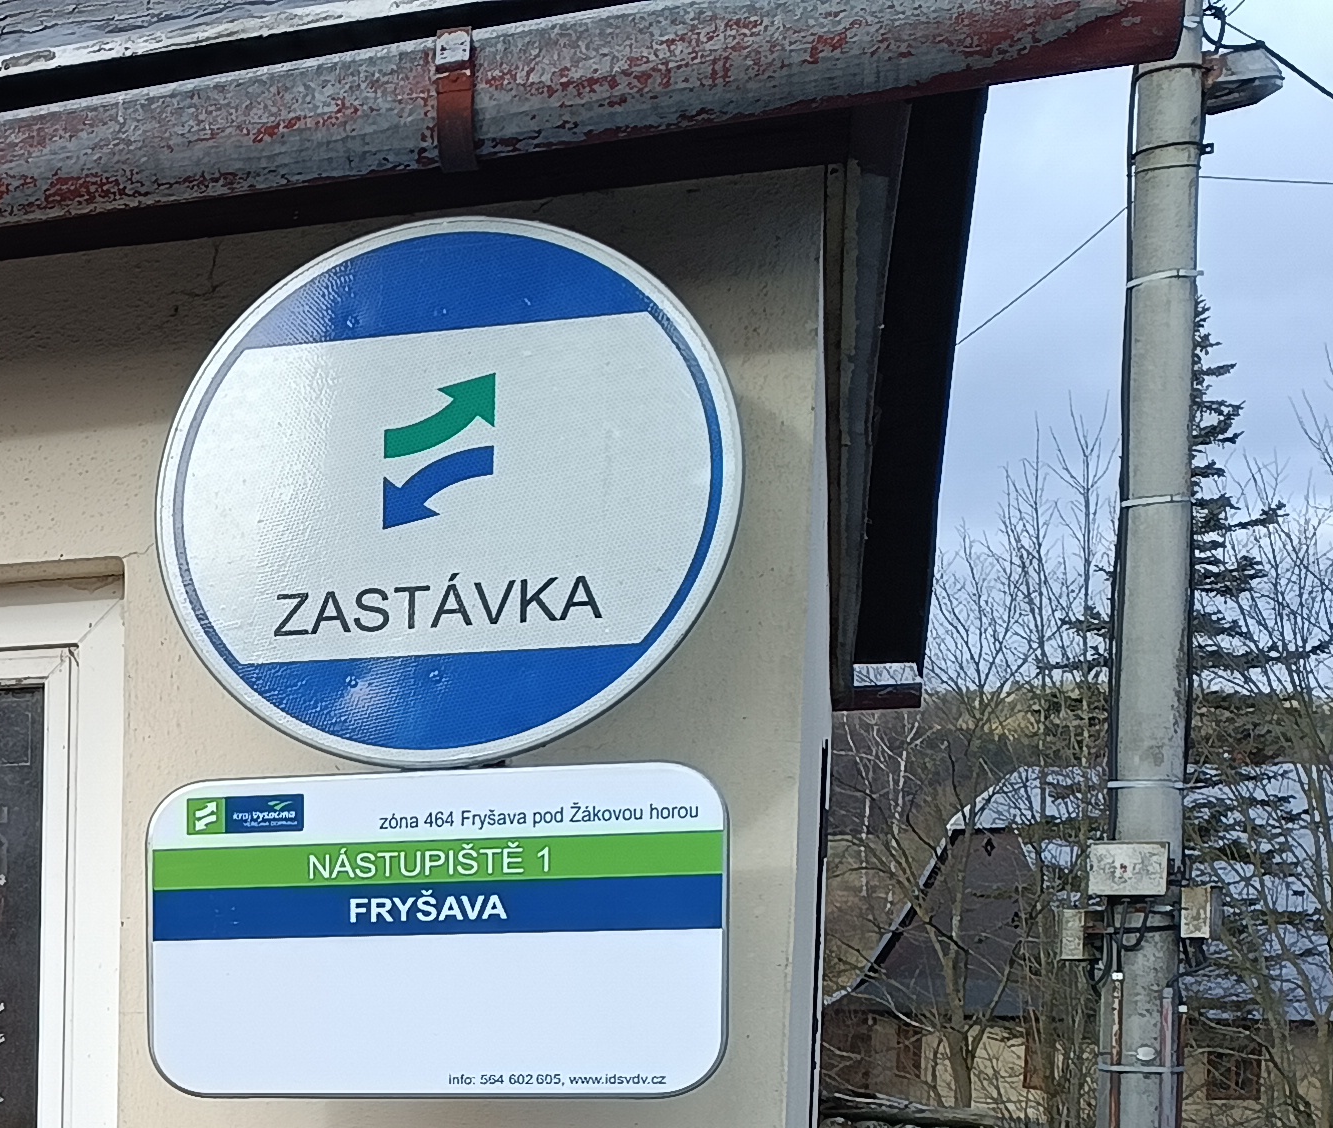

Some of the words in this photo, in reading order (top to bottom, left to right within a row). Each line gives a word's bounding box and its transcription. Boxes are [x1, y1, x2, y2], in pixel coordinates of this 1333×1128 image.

[274, 573, 602, 638] ZASTÁVKA
[379, 814, 419, 830] zóna
[424, 811, 455, 828] 464
[460, 808, 527, 831] Fryšava
[533, 806, 564, 828] pod
[569, 802, 643, 823] Žákovou
[649, 803, 699, 820] horou
[308, 841, 524, 880] NÁSTUPIŠTĚ
[537, 847, 551, 873] 1
[349, 890, 507, 923] FRYŠAVA
[480, 1074, 504, 1085] 564
[509, 1074, 533, 1085] 602
[536, 1074, 564, 1087] 605,
[569, 1074, 667, 1085] www.idsvdv.cz
